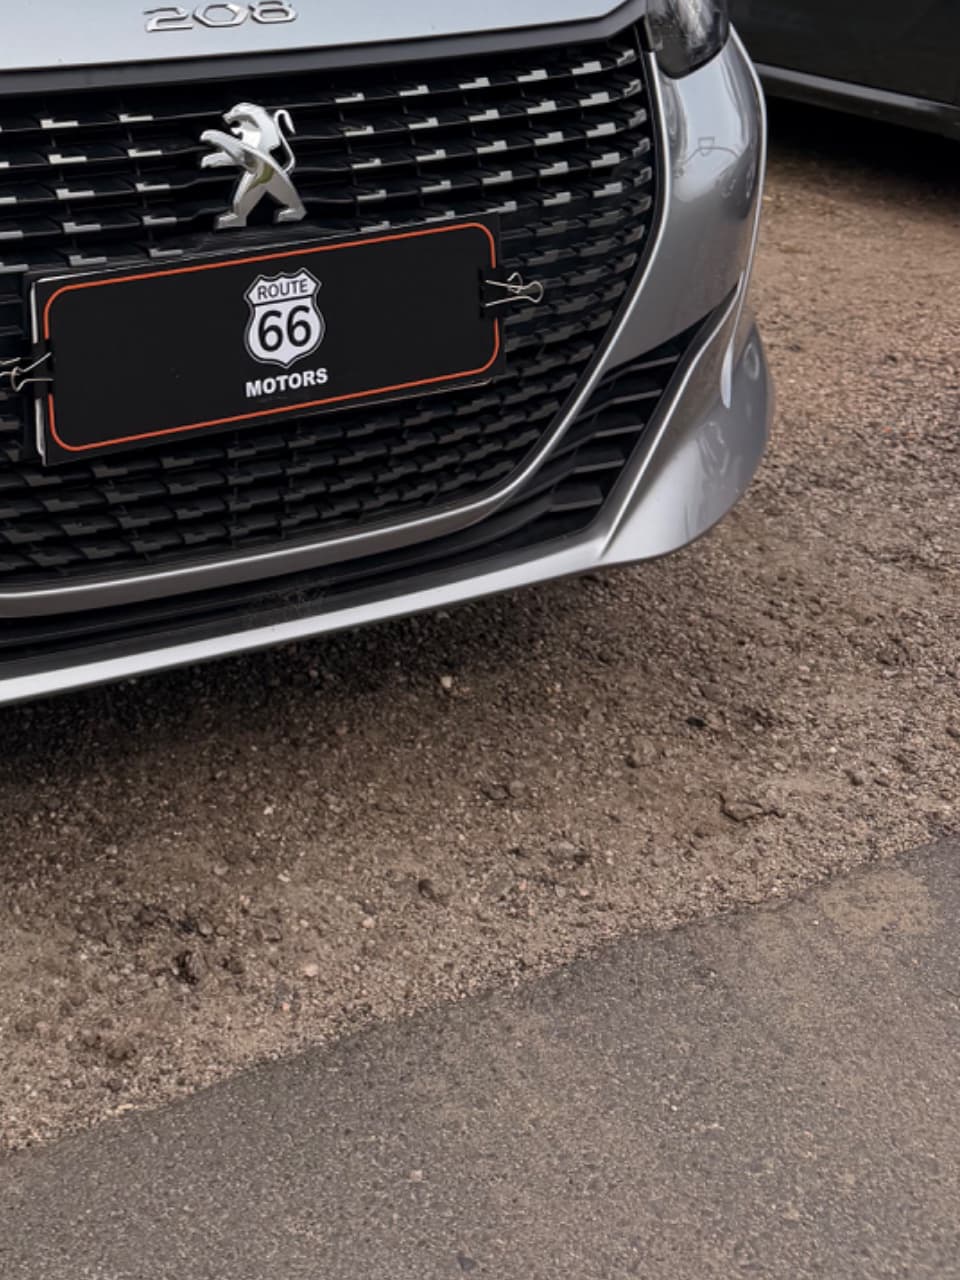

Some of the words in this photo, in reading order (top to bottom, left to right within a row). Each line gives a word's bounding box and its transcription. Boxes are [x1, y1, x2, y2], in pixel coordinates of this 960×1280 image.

[143, 0, 298, 33] 208
[257, 278, 309, 301] ROUTE
[258, 305, 311, 352] 66
[245, 368, 328, 398] MOTORS
